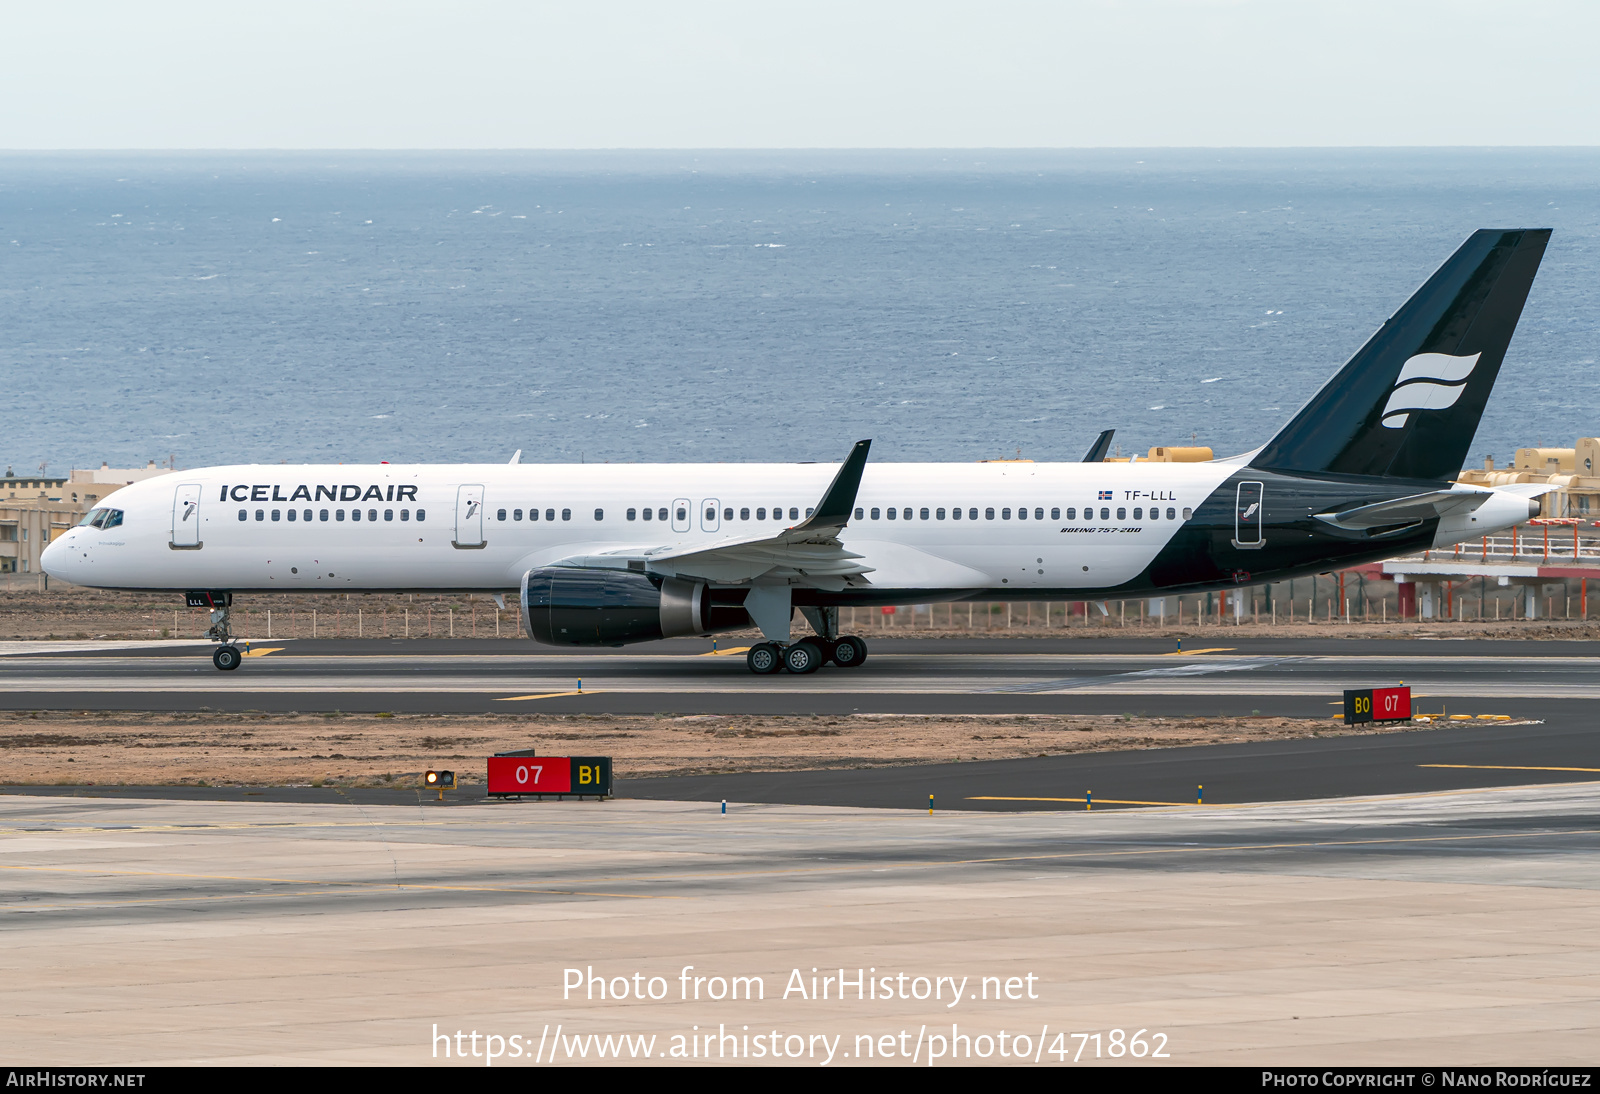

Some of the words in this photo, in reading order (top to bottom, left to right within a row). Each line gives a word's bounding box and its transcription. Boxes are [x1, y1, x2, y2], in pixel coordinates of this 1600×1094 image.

[220, 485, 418, 502] ICELANDAIR
[1124, 490, 1177, 501] TF-LLL
[1385, 695, 1399, 712] 07
[515, 765, 543, 785] 07
[579, 765, 600, 785] B1
